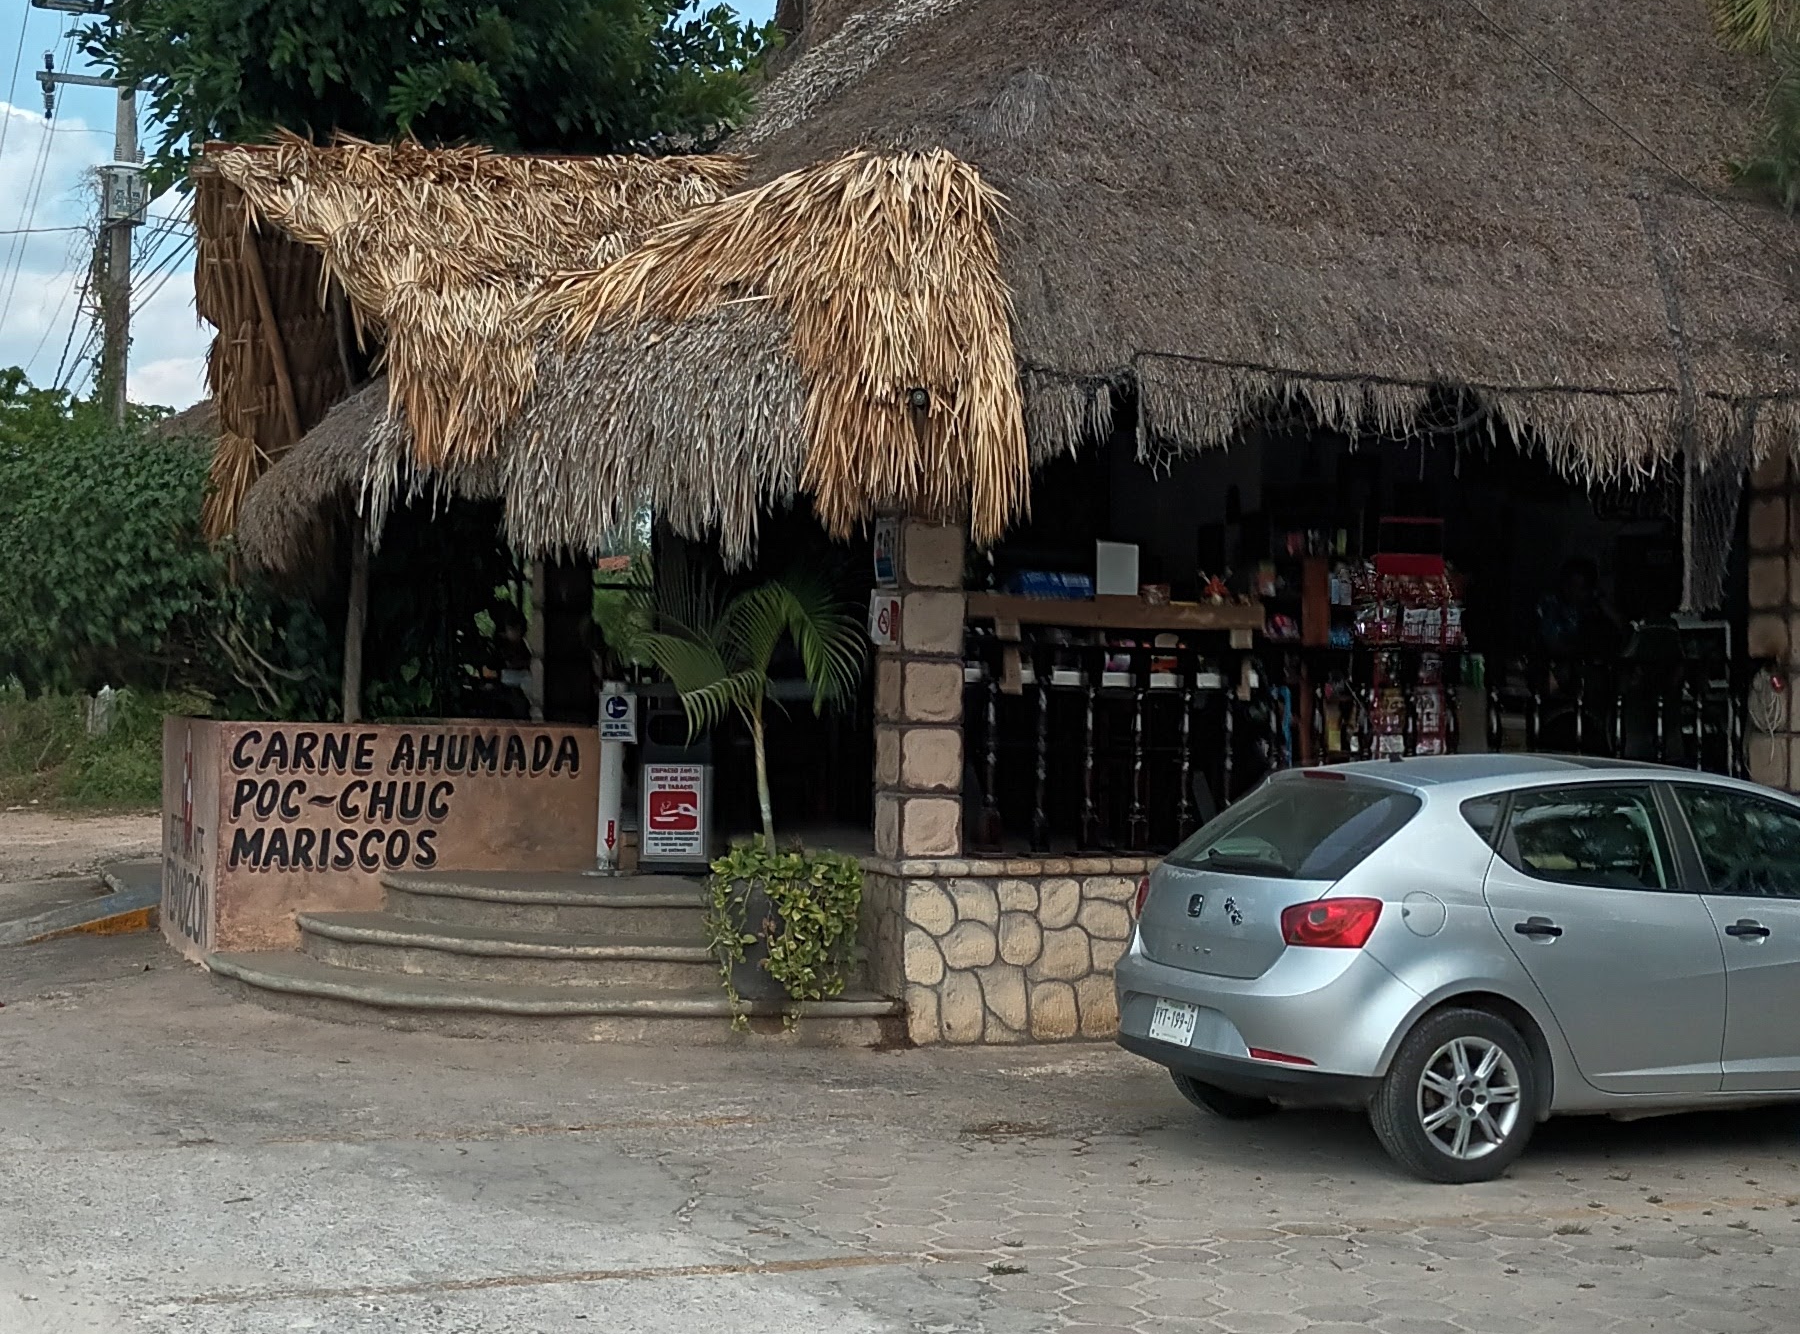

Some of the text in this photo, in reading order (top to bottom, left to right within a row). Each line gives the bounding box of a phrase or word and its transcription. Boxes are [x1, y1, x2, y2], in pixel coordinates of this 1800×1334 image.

[231, 730, 580, 776] CARNE AHUMADA
[229, 827, 438, 870] MARISCOS
